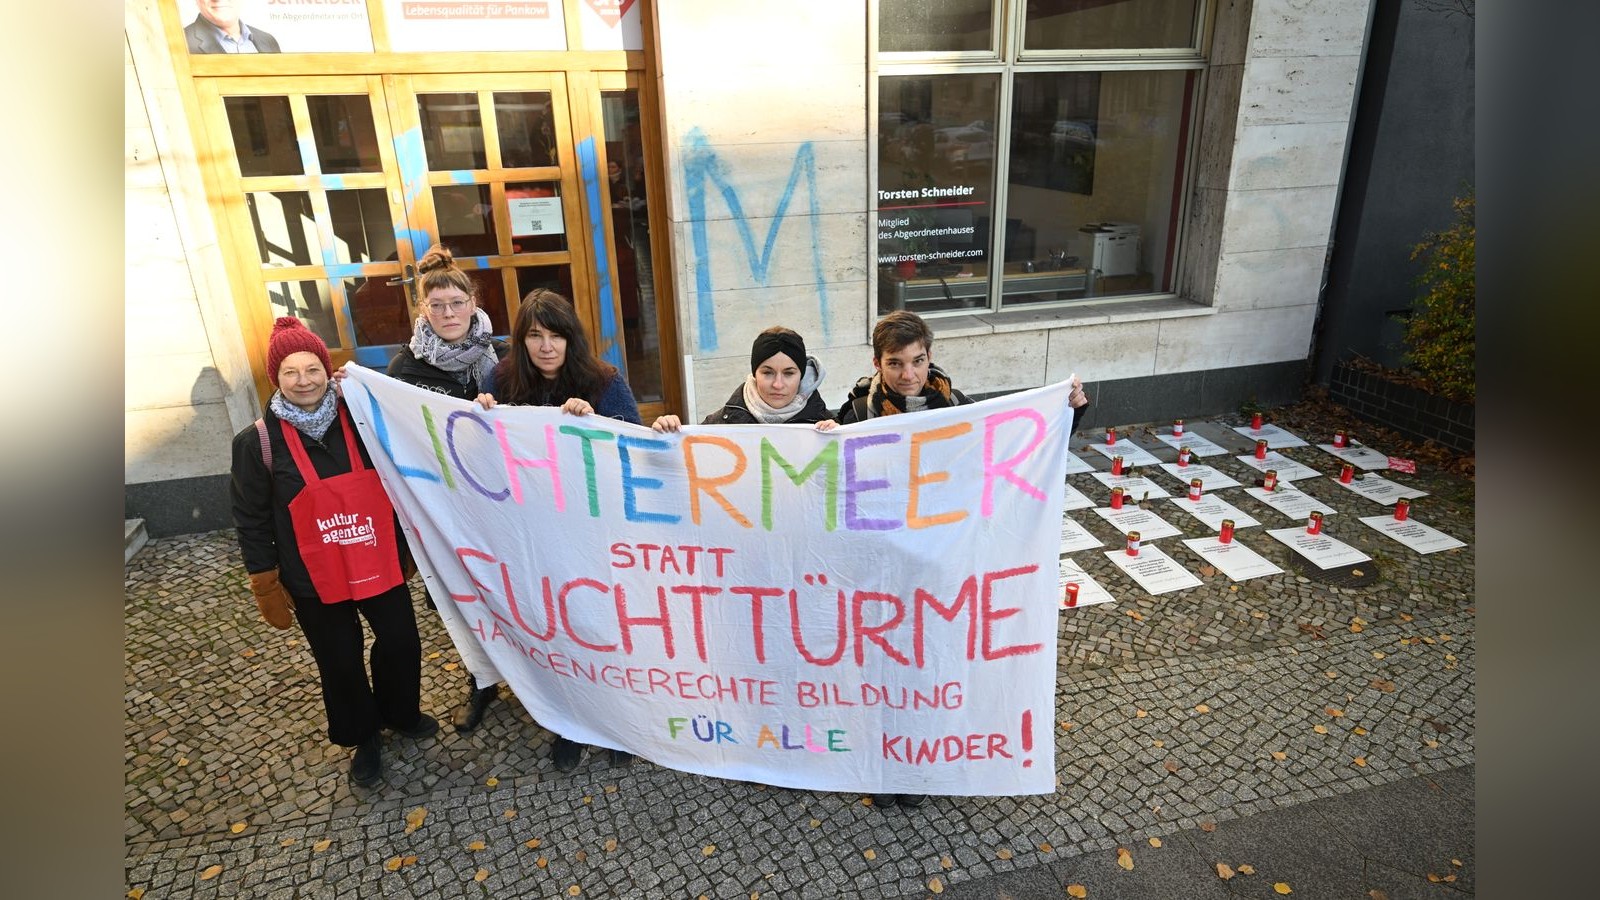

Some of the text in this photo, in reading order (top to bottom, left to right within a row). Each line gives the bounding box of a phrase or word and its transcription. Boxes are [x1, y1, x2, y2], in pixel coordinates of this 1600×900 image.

[405, 4, 546, 18] Lebensqualität für Pankow
[878, 185, 975, 200] Torsten Schneider
[878, 217, 910, 229] Mitglied
[878, 226, 975, 240] des Abgeordnetenhauses
[878, 248, 983, 264] www.torsten-schneider.com
[361, 383, 1048, 531] LICHTERMEER
[316, 513, 359, 531] kultur
[611, 542, 735, 577] STATT
[470, 617, 963, 710] HANCENGERECHTE BILDUNG
[667, 714, 739, 746] FÜR
[757, 723, 852, 753] ALLE
